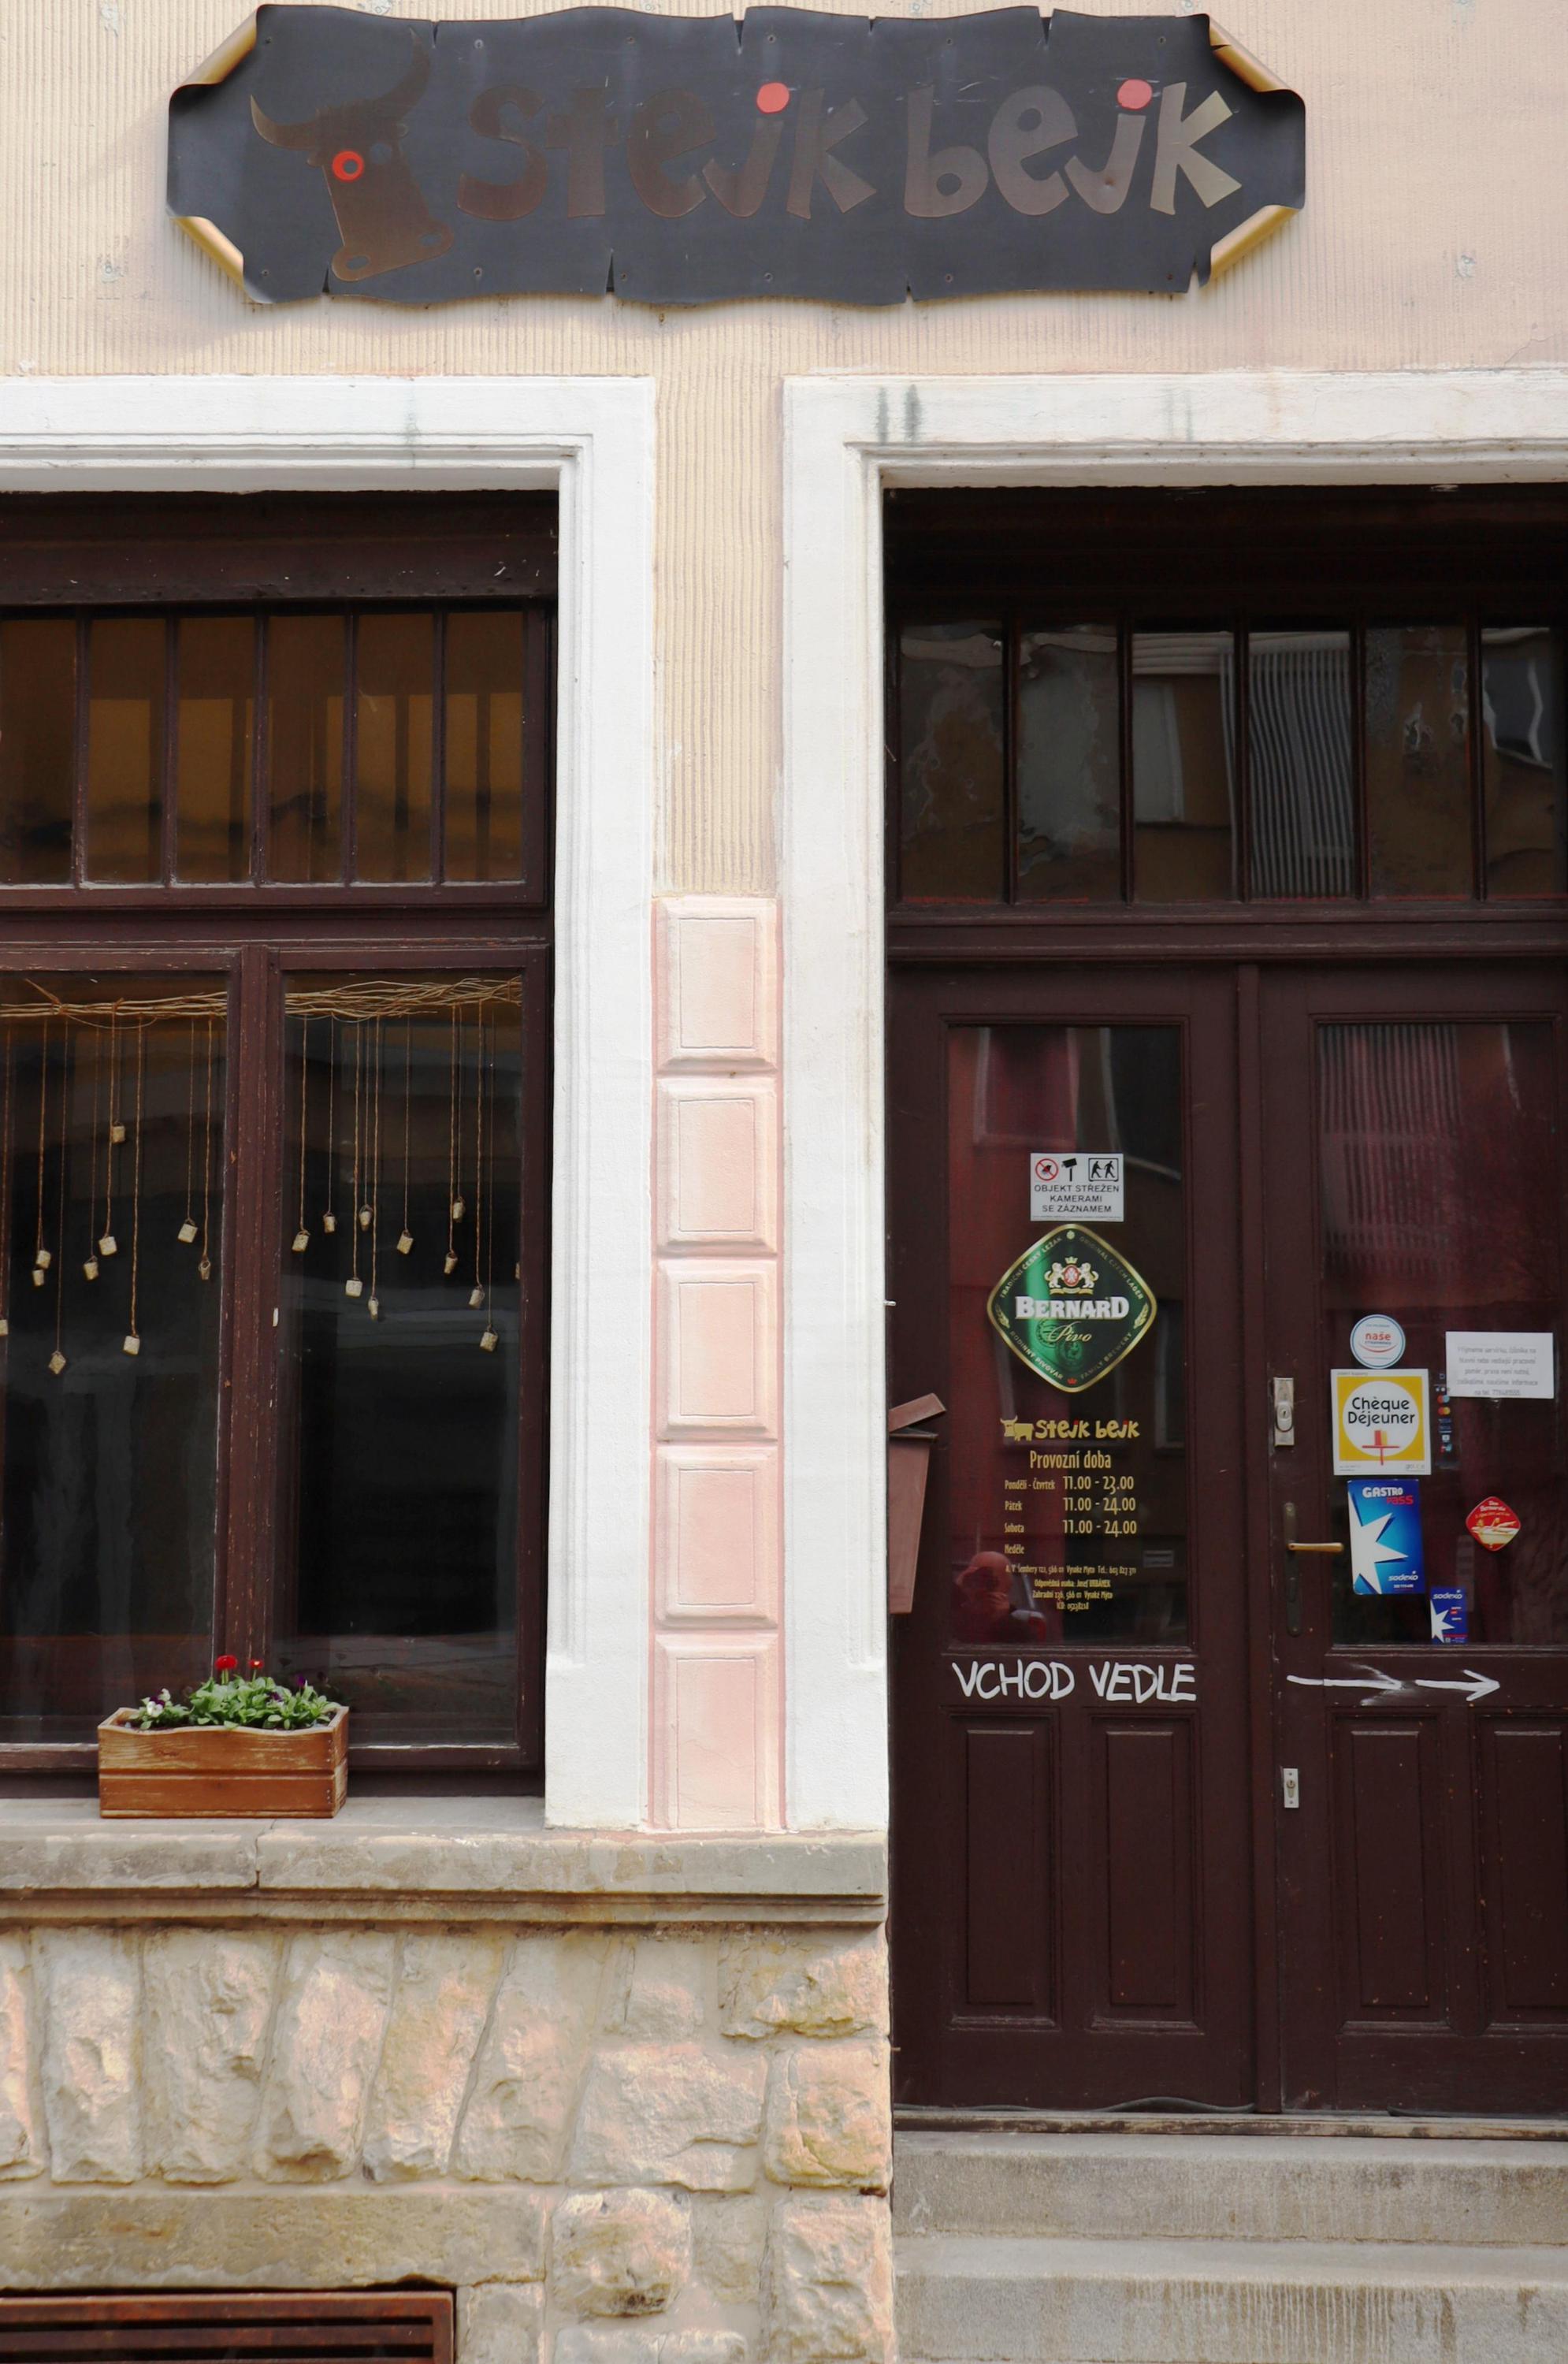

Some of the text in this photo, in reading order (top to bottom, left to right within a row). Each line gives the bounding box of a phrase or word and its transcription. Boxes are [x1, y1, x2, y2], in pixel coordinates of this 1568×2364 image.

[1076, 1184, 1119, 1192] STŘEŽEN
[1057, 1203, 1112, 1213] ZÁZNAMEM
[1126, 1278, 1144, 1300] LAGER
[1015, 1295, 1130, 1320] BERNARD
[1048, 1321, 1093, 1343] Pivo
[1035, 1357, 1064, 1380] PIVOVAR
[1352, 1396, 1410, 1413] Chèque
[1347, 1410, 1416, 1427] Déjeuner
[1029, 1450, 1112, 1469] Provozní doba
[1062, 1476, 1091, 1490] 11.00
[1102, 1476, 1135, 1495] 23.00
[1362, 1486, 1404, 1499] GASTRO
[1005, 1500, 1023, 1511] Pátek
[1063, 1497, 1092, 1511] 11.00
[1103, 1497, 1136, 1515] 24.00
[1004, 1522, 1024, 1533] Sobota
[1063, 1520, 1094, 1534] 11.00
[1104, 1520, 1138, 1538] 24.00
[1004, 1544, 1025, 1555] Neděle
[1388, 1570, 1418, 1582] sodexo
[1432, 1589, 1463, 1600] sodexo
[952, 1659, 1197, 1703] VCHOD VEDLE
